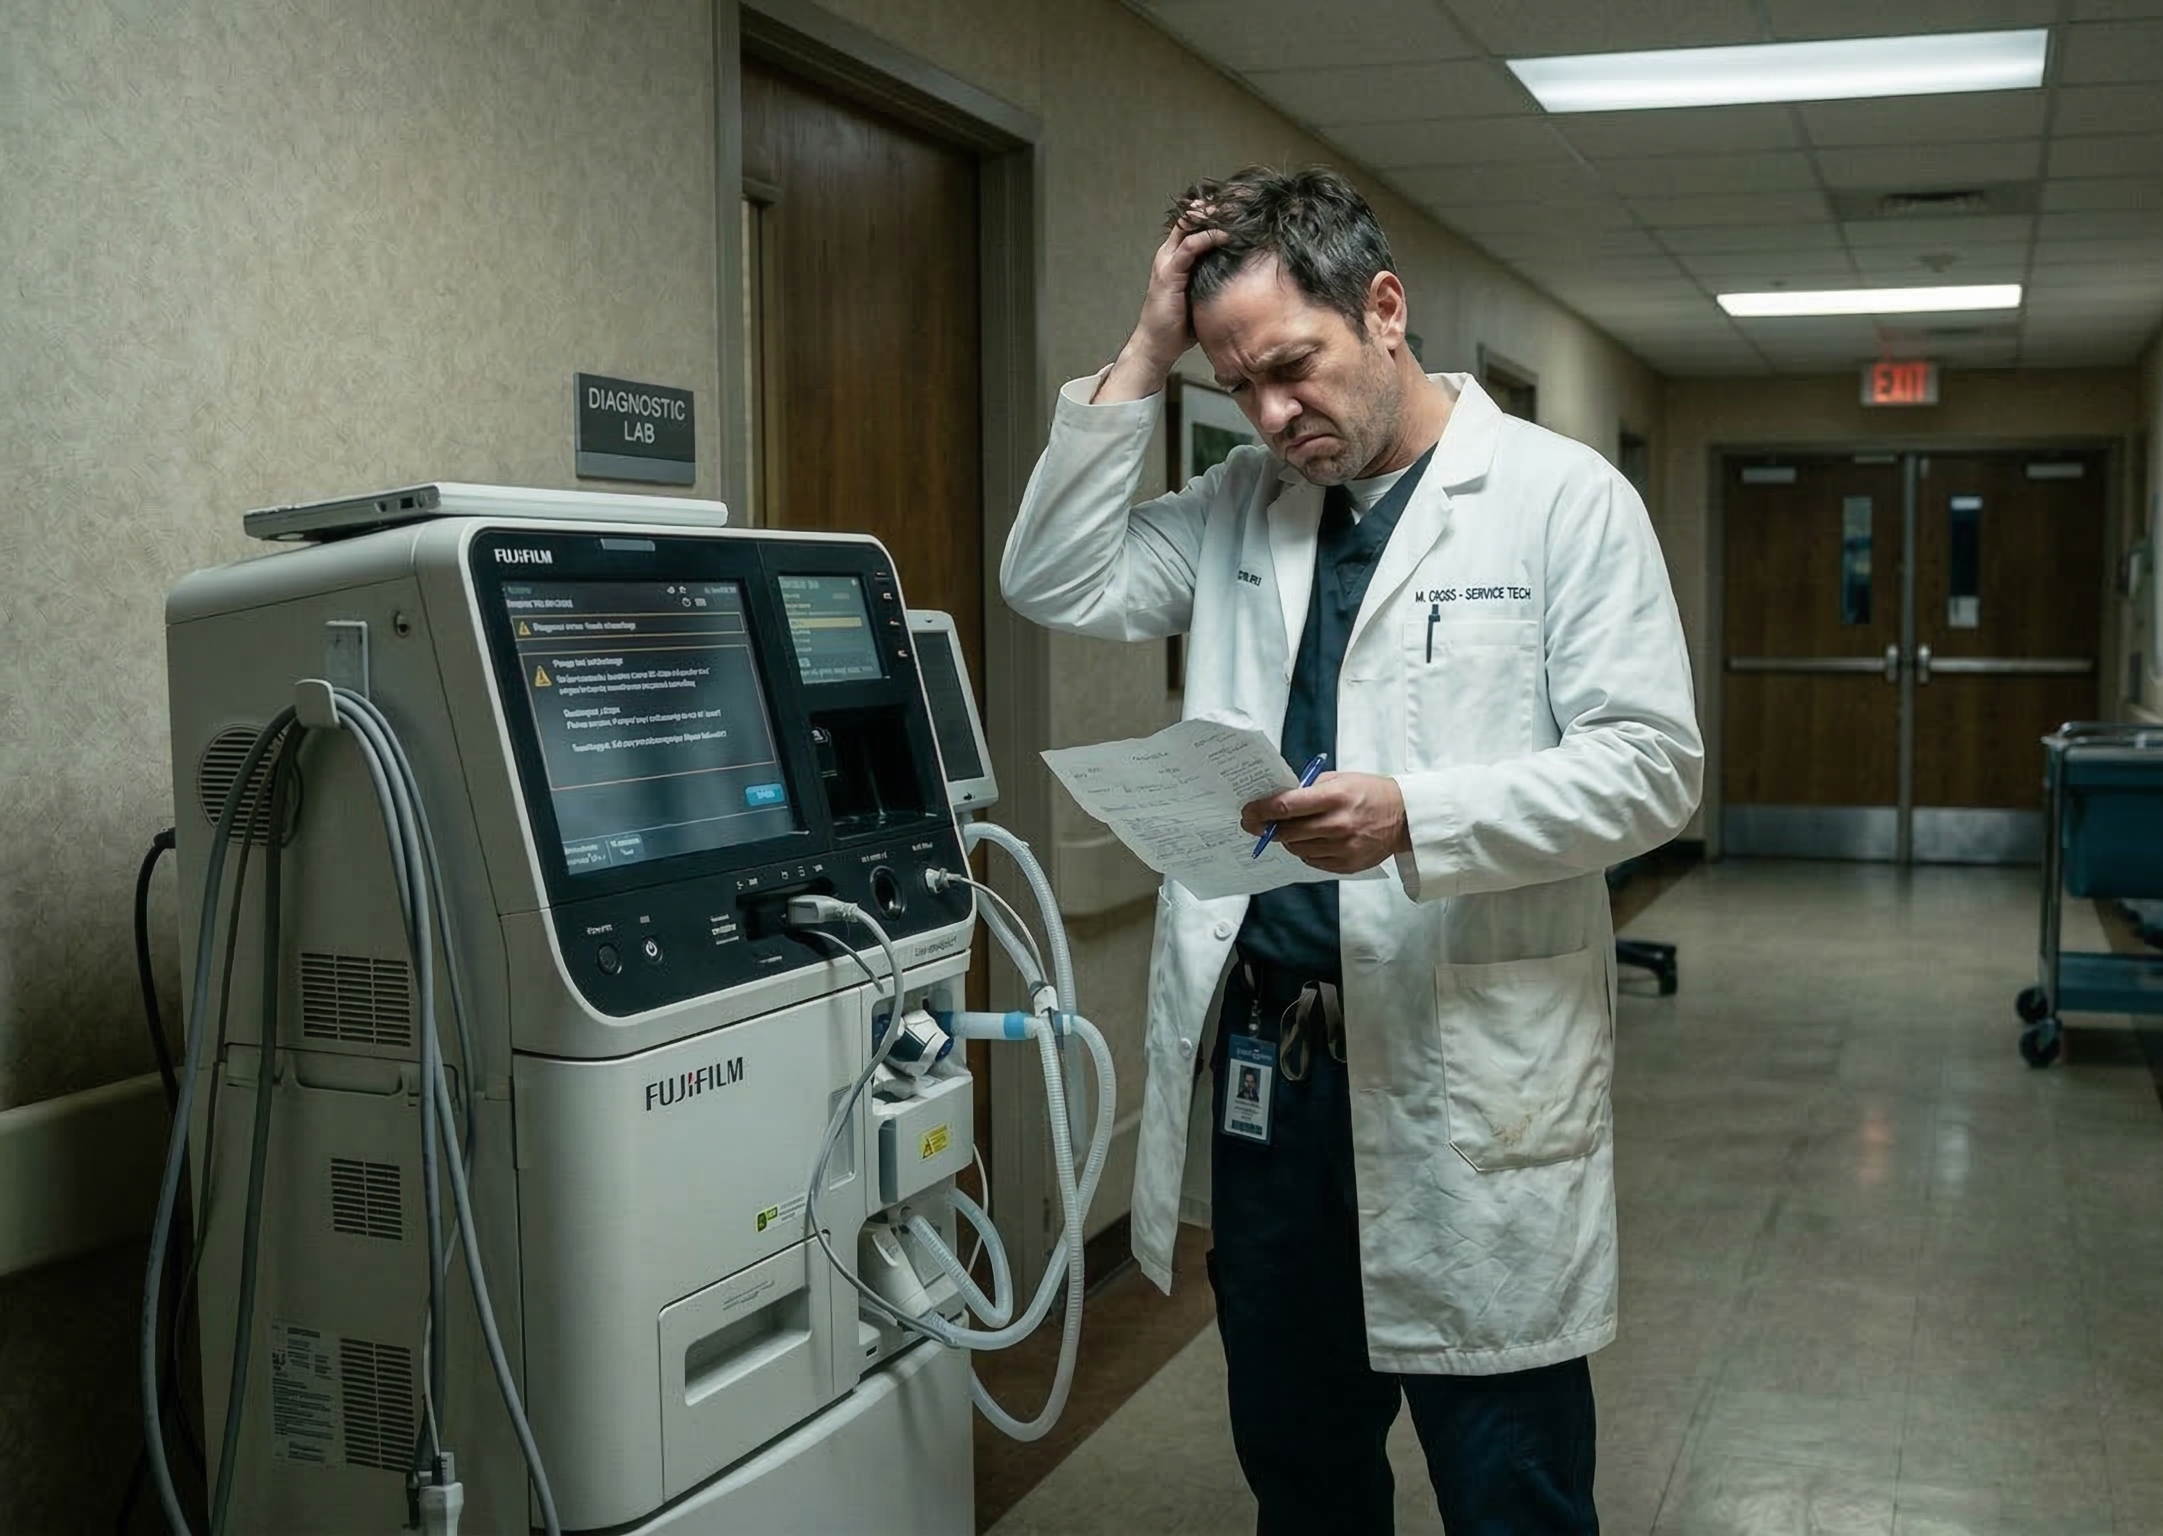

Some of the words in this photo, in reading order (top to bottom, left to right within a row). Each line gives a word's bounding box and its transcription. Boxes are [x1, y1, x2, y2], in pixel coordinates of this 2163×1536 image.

[1873, 363, 1927, 403] EXIT
[588, 387, 686, 421] DIAGNOSTIC
[624, 420, 655, 444] LAB
[1465, 586, 1505, 600] SERVICE
[1507, 586, 1531, 600] TECH
[645, 1056, 744, 1112] FUJIFILM
